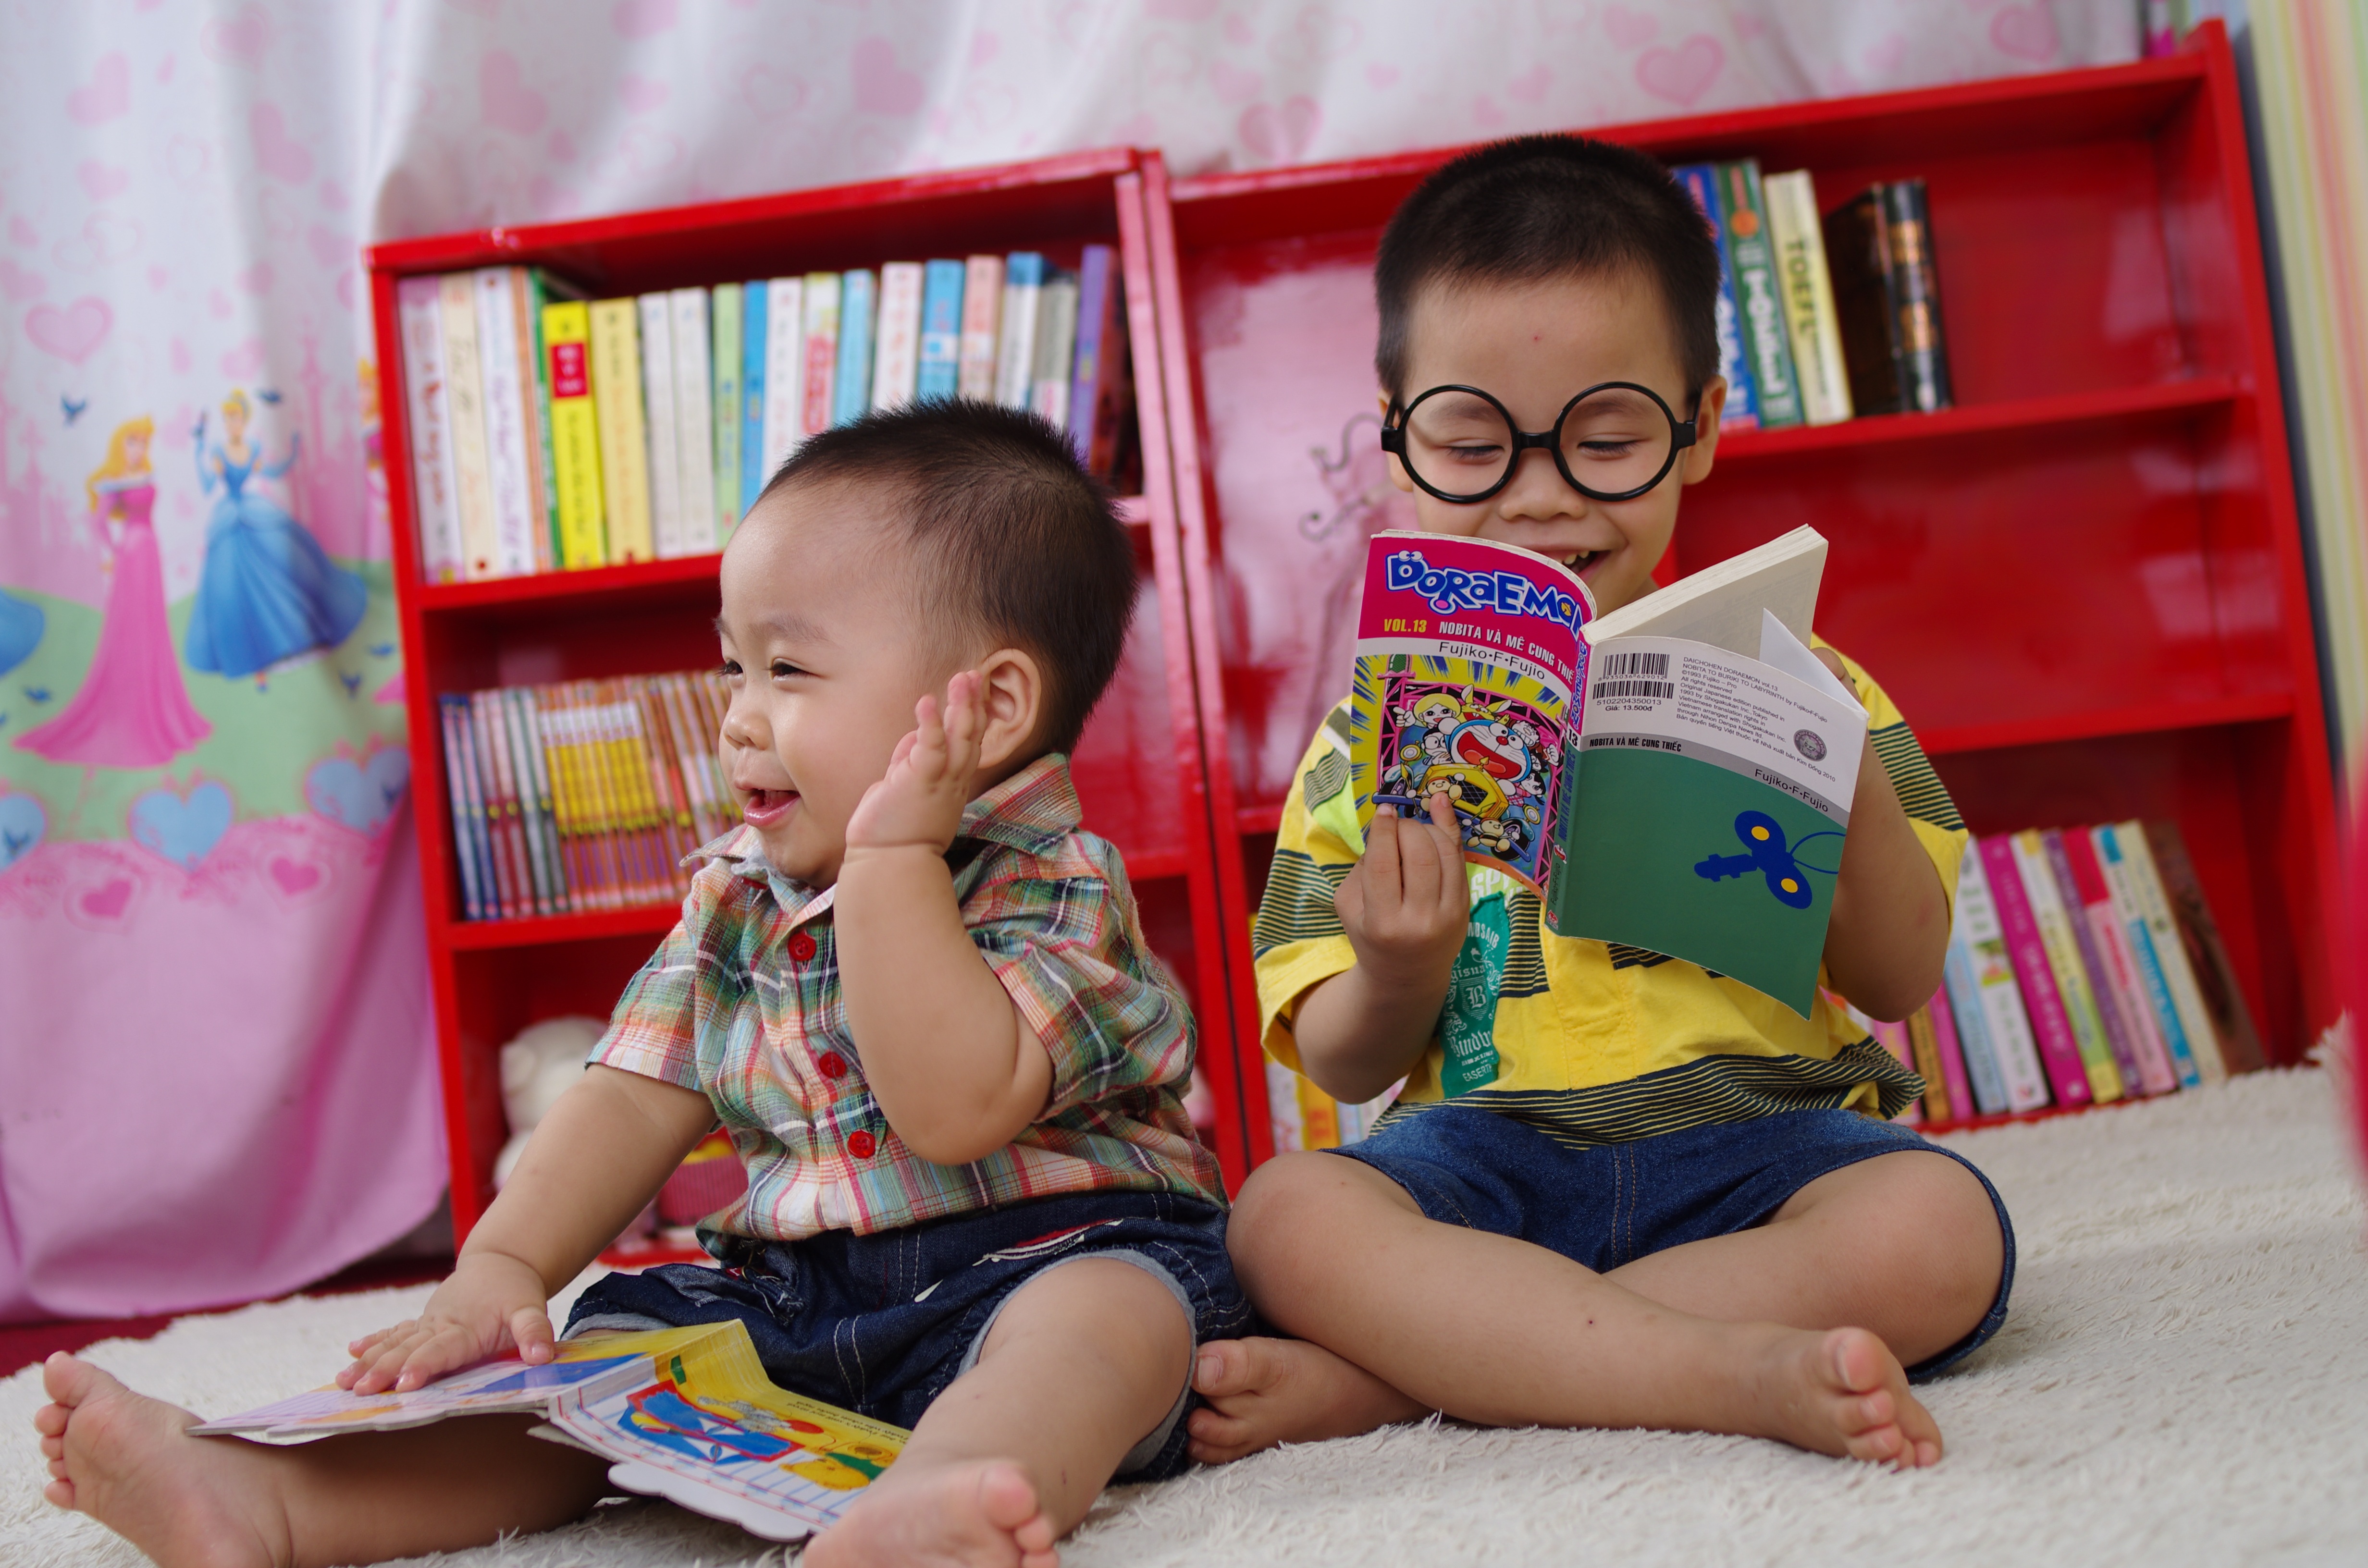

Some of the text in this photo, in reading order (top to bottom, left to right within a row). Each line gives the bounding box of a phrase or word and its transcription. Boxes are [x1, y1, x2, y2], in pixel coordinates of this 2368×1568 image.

[1384, 618, 1574, 685] VOL.13 NOBITA VÀ MÊ CUNG THIẾ
[1683, 657, 1778, 691] DAICHOHEN DORAEMON vol.13
[1683, 663, 1706, 673] NOBITA
[1718, 672, 1739, 683] BURIKI
[1751, 683, 1785, 701] LABYRINTH
[1786, 698, 1792, 706] by
[1702, 674, 1720, 684] Fujiko
[1680, 683, 1702, 692] Original
[1704, 688, 1731, 700] Japanese
[1733, 697, 1751, 708] edition
[1752, 705, 1778, 719] published
[1704, 695, 1739, 710] Shogakukan
[1707, 683, 1732, 694] reserved
[1677, 708, 1699, 717] through
[1700, 713, 1717, 722] Nihon
[1718, 719, 1737, 729] Denpa
[1738, 725, 1753, 735] News
[1678, 695, 1712, 708] Vietnamese
[1714, 704, 1742, 717] translation
[1744, 714, 1759, 724] rights
[1678, 701, 1701, 711] Vietnam
[1702, 709, 1728, 719] arranged
[1742, 720, 1776, 737] Shogakukan
[1776, 734, 1786, 743] Inc.
[1568, 729, 1578, 747] 13
[1590, 736, 1681, 752] NOBITA VÀ MÊ CUNG THIẾC
[1736, 731, 1751, 741] thuộc
[1760, 740, 1772, 749] Nhà
[1785, 751, 1796, 760] bản
[1797, 757, 1807, 767] Kim
[1823, 771, 1836, 782] 2010
[1466, 985, 1487, 1009] B
